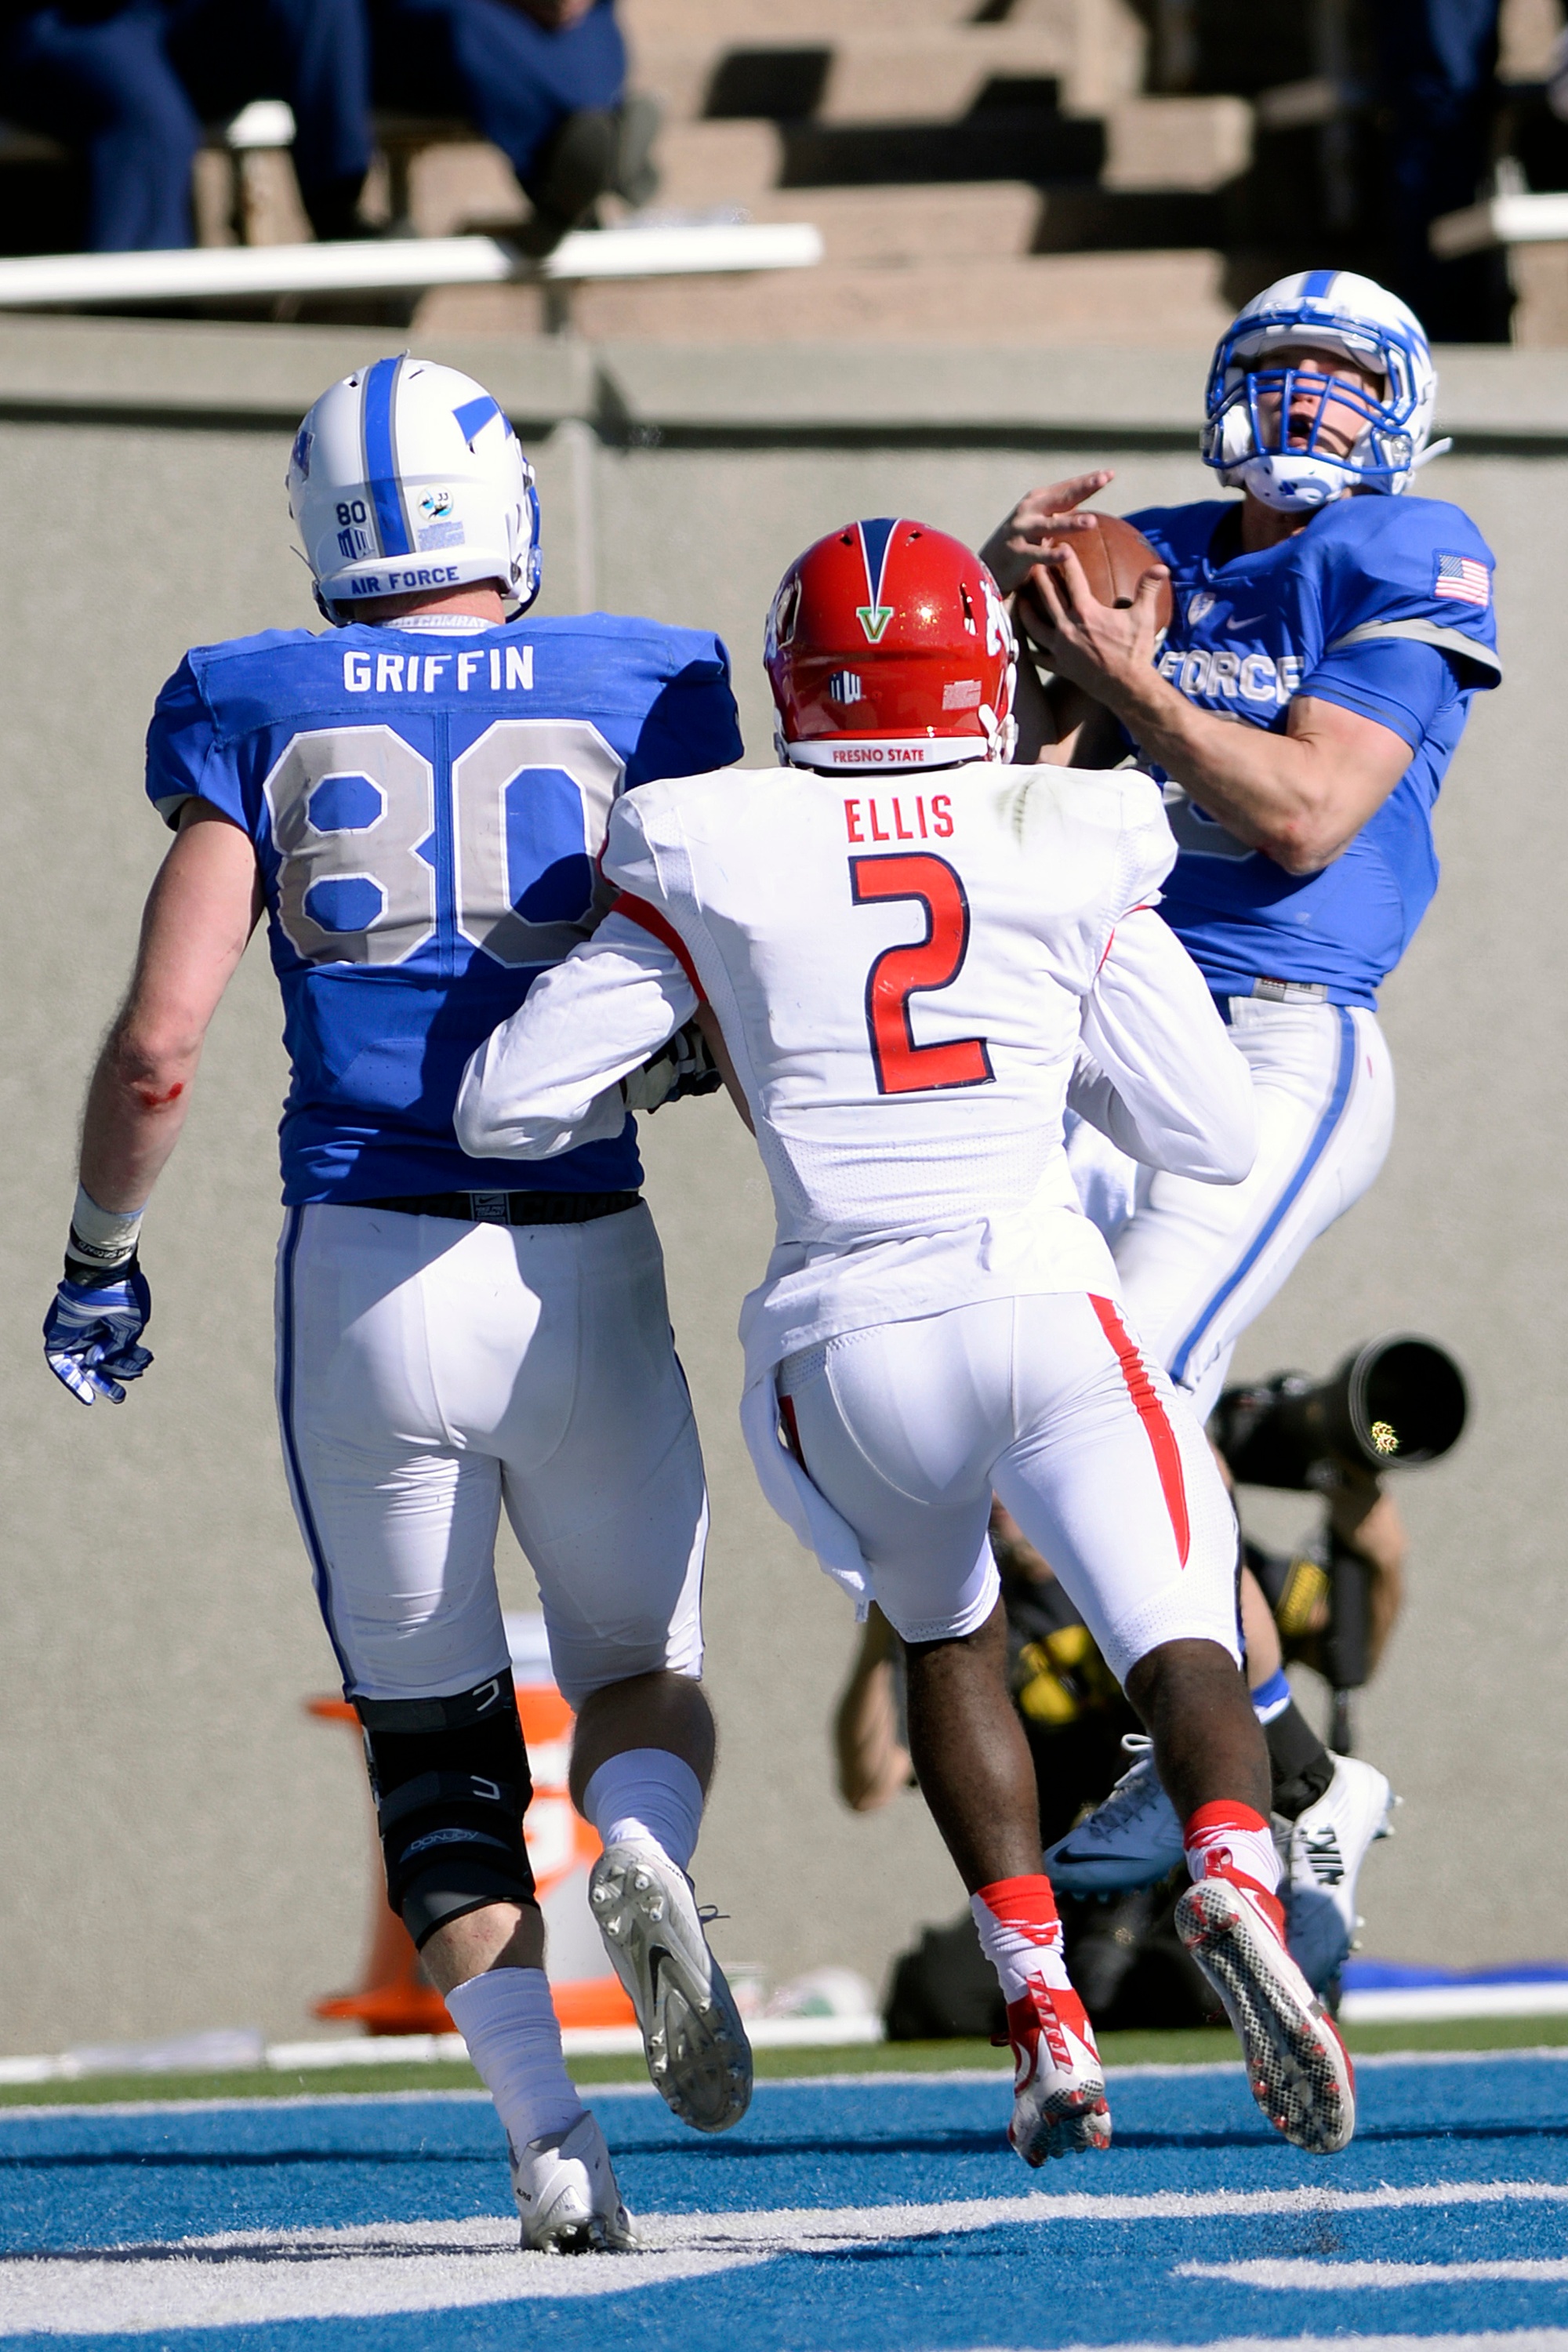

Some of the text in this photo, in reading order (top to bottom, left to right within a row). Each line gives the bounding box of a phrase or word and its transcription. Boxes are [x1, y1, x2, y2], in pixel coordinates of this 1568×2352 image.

[336, 499, 366, 526] 80
[351, 566, 460, 595] AIR FORCE
[343, 644, 535, 694] GRIFFIN
[1157, 649, 1305, 705] FORCE
[833, 749, 924, 763] FRESNO STATE
[844, 794, 955, 843] ELLIS
[263, 719, 626, 968] 80
[848, 851, 996, 1095] 2
[410, 1831, 479, 1850] DONJOY
